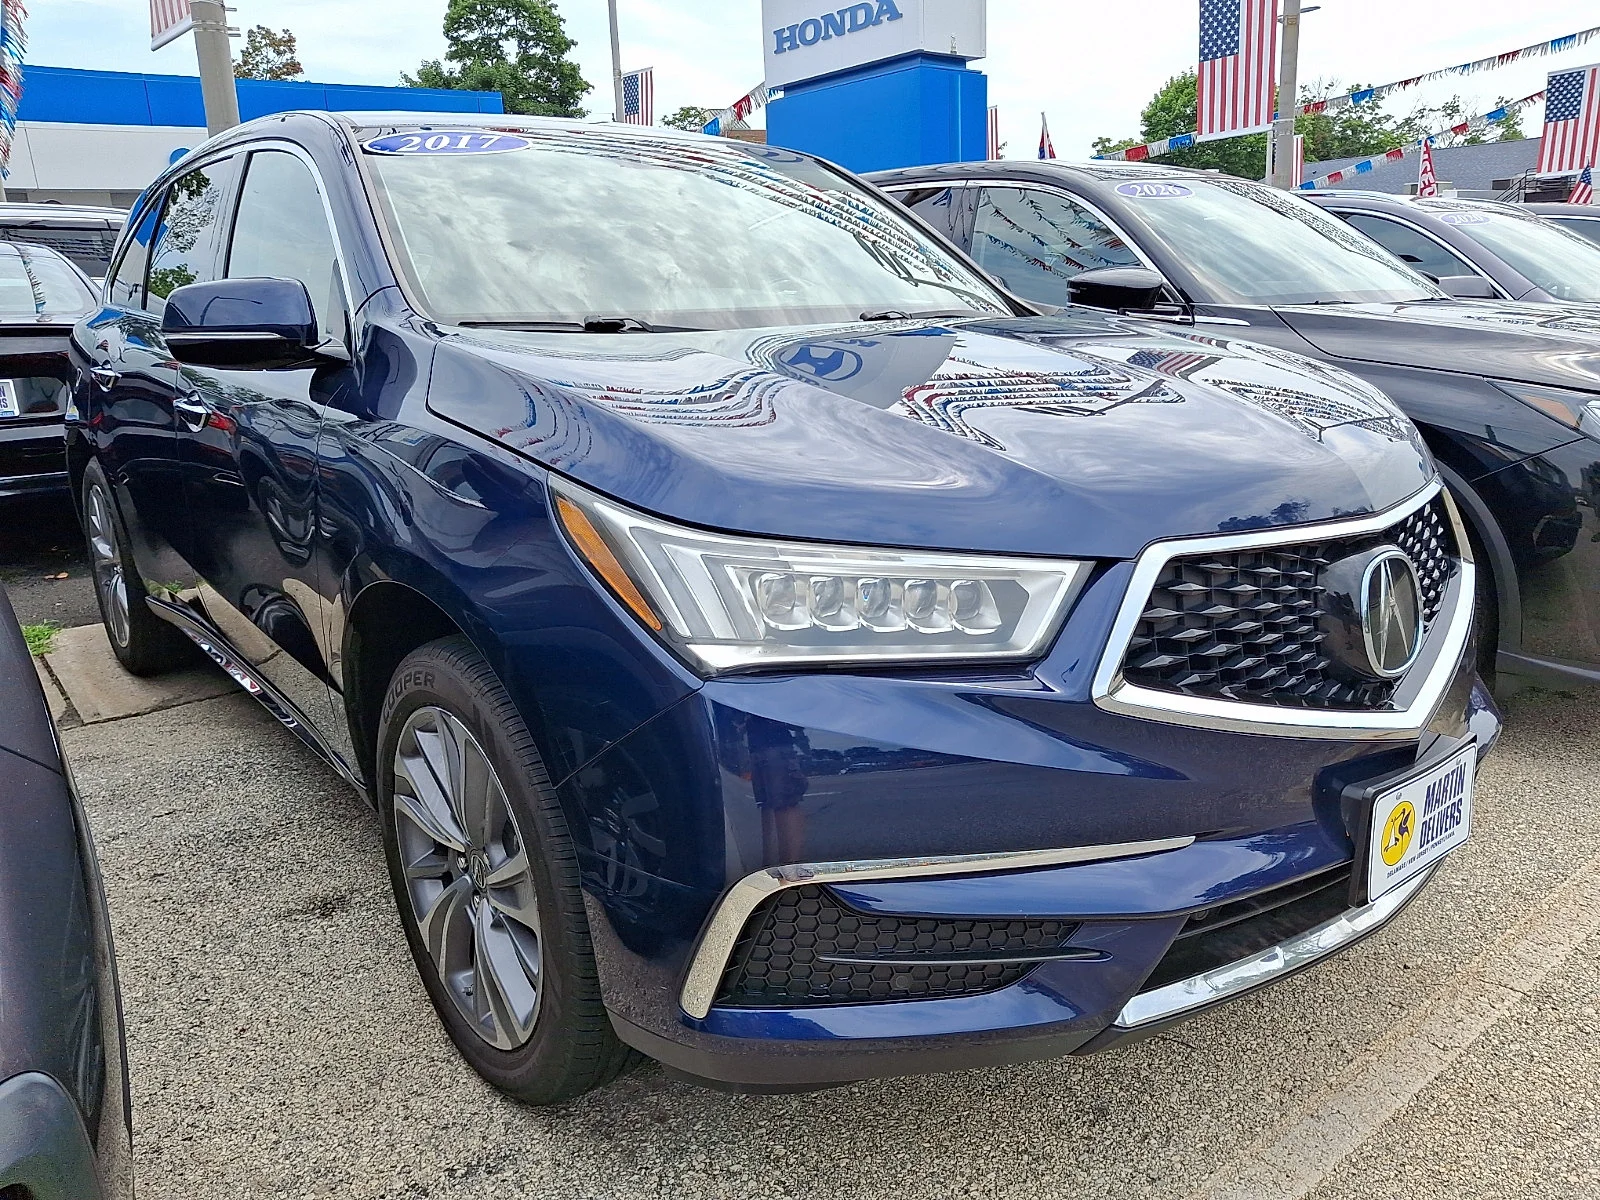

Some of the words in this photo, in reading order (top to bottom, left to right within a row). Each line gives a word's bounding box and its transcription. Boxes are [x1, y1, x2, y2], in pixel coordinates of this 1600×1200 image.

[773, 0, 903, 54] HONDA
[395, 134, 503, 152] 2017
[1129, 183, 1181, 197] 2026
[383, 670, 436, 724] COOPER
[1423, 762, 1467, 818] MARTIN
[1419, 797, 1463, 850] DELIVERS
